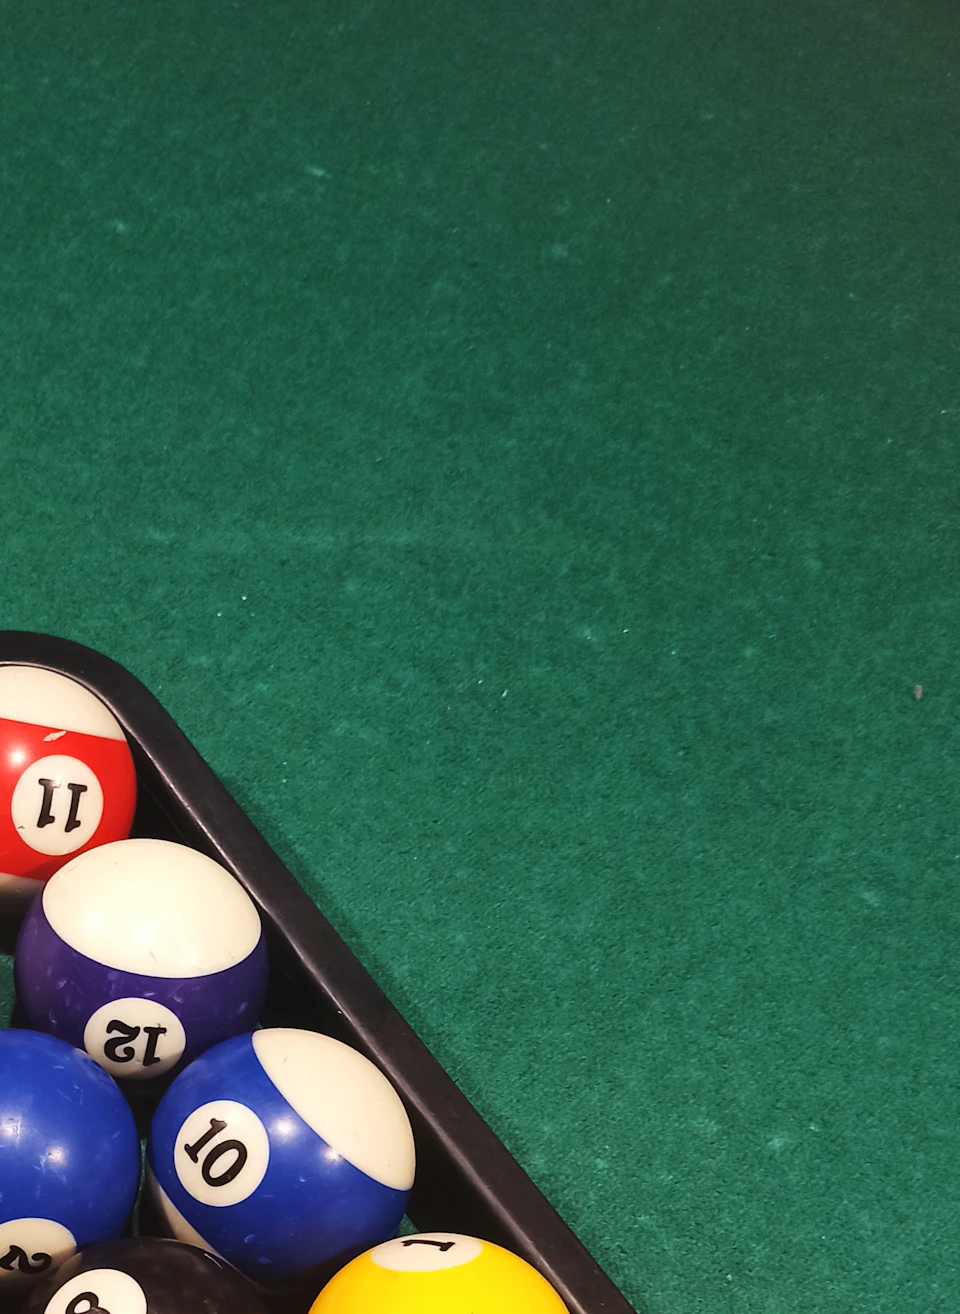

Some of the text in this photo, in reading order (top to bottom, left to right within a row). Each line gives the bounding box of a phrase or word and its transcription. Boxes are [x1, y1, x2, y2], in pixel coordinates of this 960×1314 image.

[36, 778, 88, 834] 11
[105, 1020, 168, 1067] 12
[184, 1117, 248, 1188] 10
[400, 1239, 456, 1252] 1
